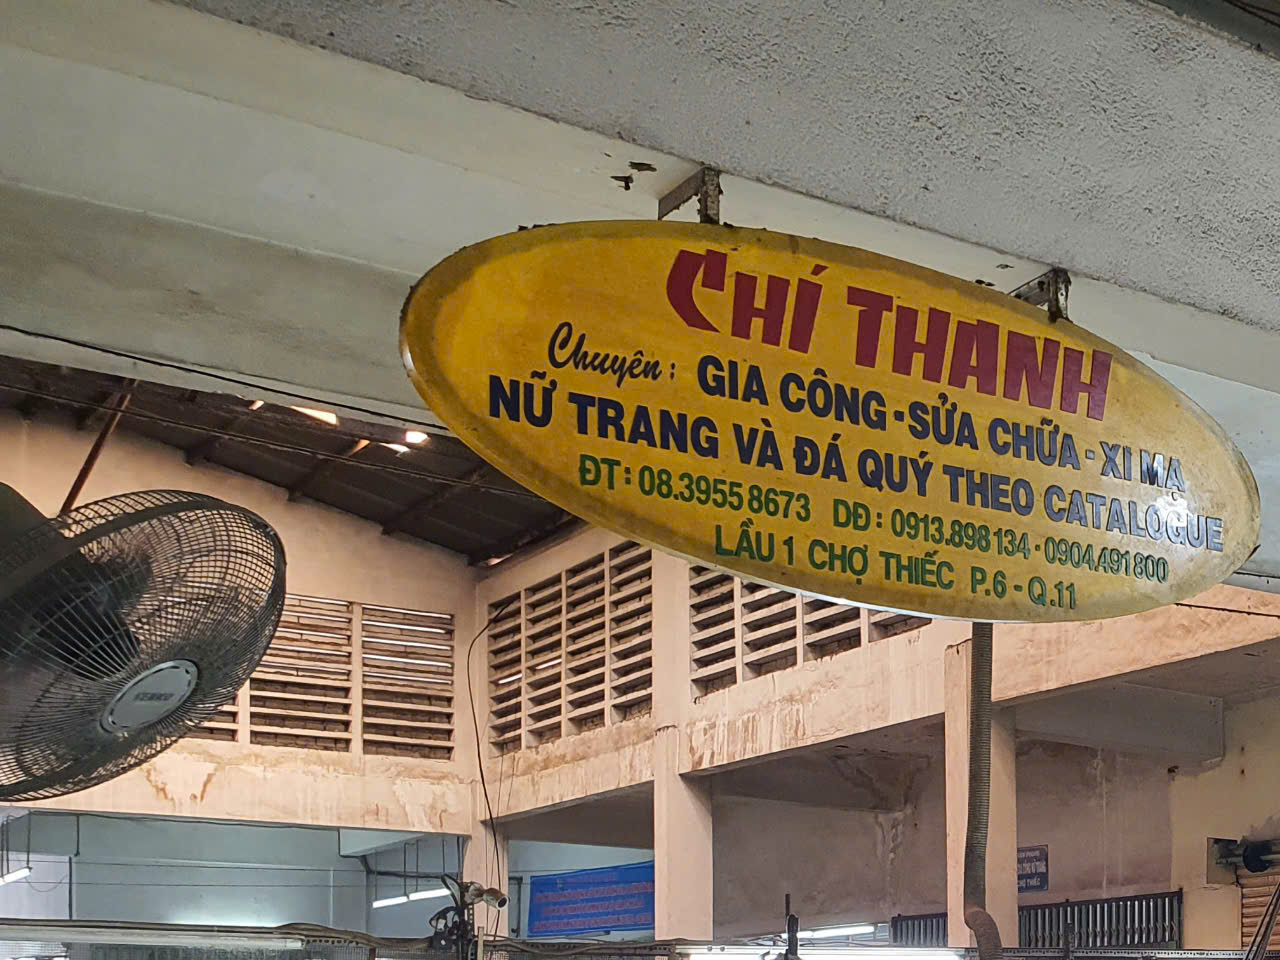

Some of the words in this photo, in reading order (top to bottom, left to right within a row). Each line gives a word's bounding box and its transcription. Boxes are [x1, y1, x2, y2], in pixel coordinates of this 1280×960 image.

[666, 248, 829, 354] CHÍ
[847, 286, 1112, 421] THANH
[488, 371, 557, 429] NỮ
[567, 391, 720, 459] TRANG
[732, 417, 784, 471] VÀ
[793, 433, 847, 483] ĐÁ
[858, 449, 934, 497] QUÝ
[943, 464, 1034, 516] THEO
[1045, 487, 1224, 552] CATALOGUE
[697, 355, 770, 406] GIA
[779, 367, 887, 431] CÔNG
[988, 417, 1081, 470] CHỮA
[1101, 441, 1133, 482] XI
[1140, 449, 1186, 502] MẠ
[714, 517, 775, 562] LẦU
[783, 536, 795, 566] 1
[808, 539, 869, 585] CHỢ
[879, 549, 955, 590] THIẾC
